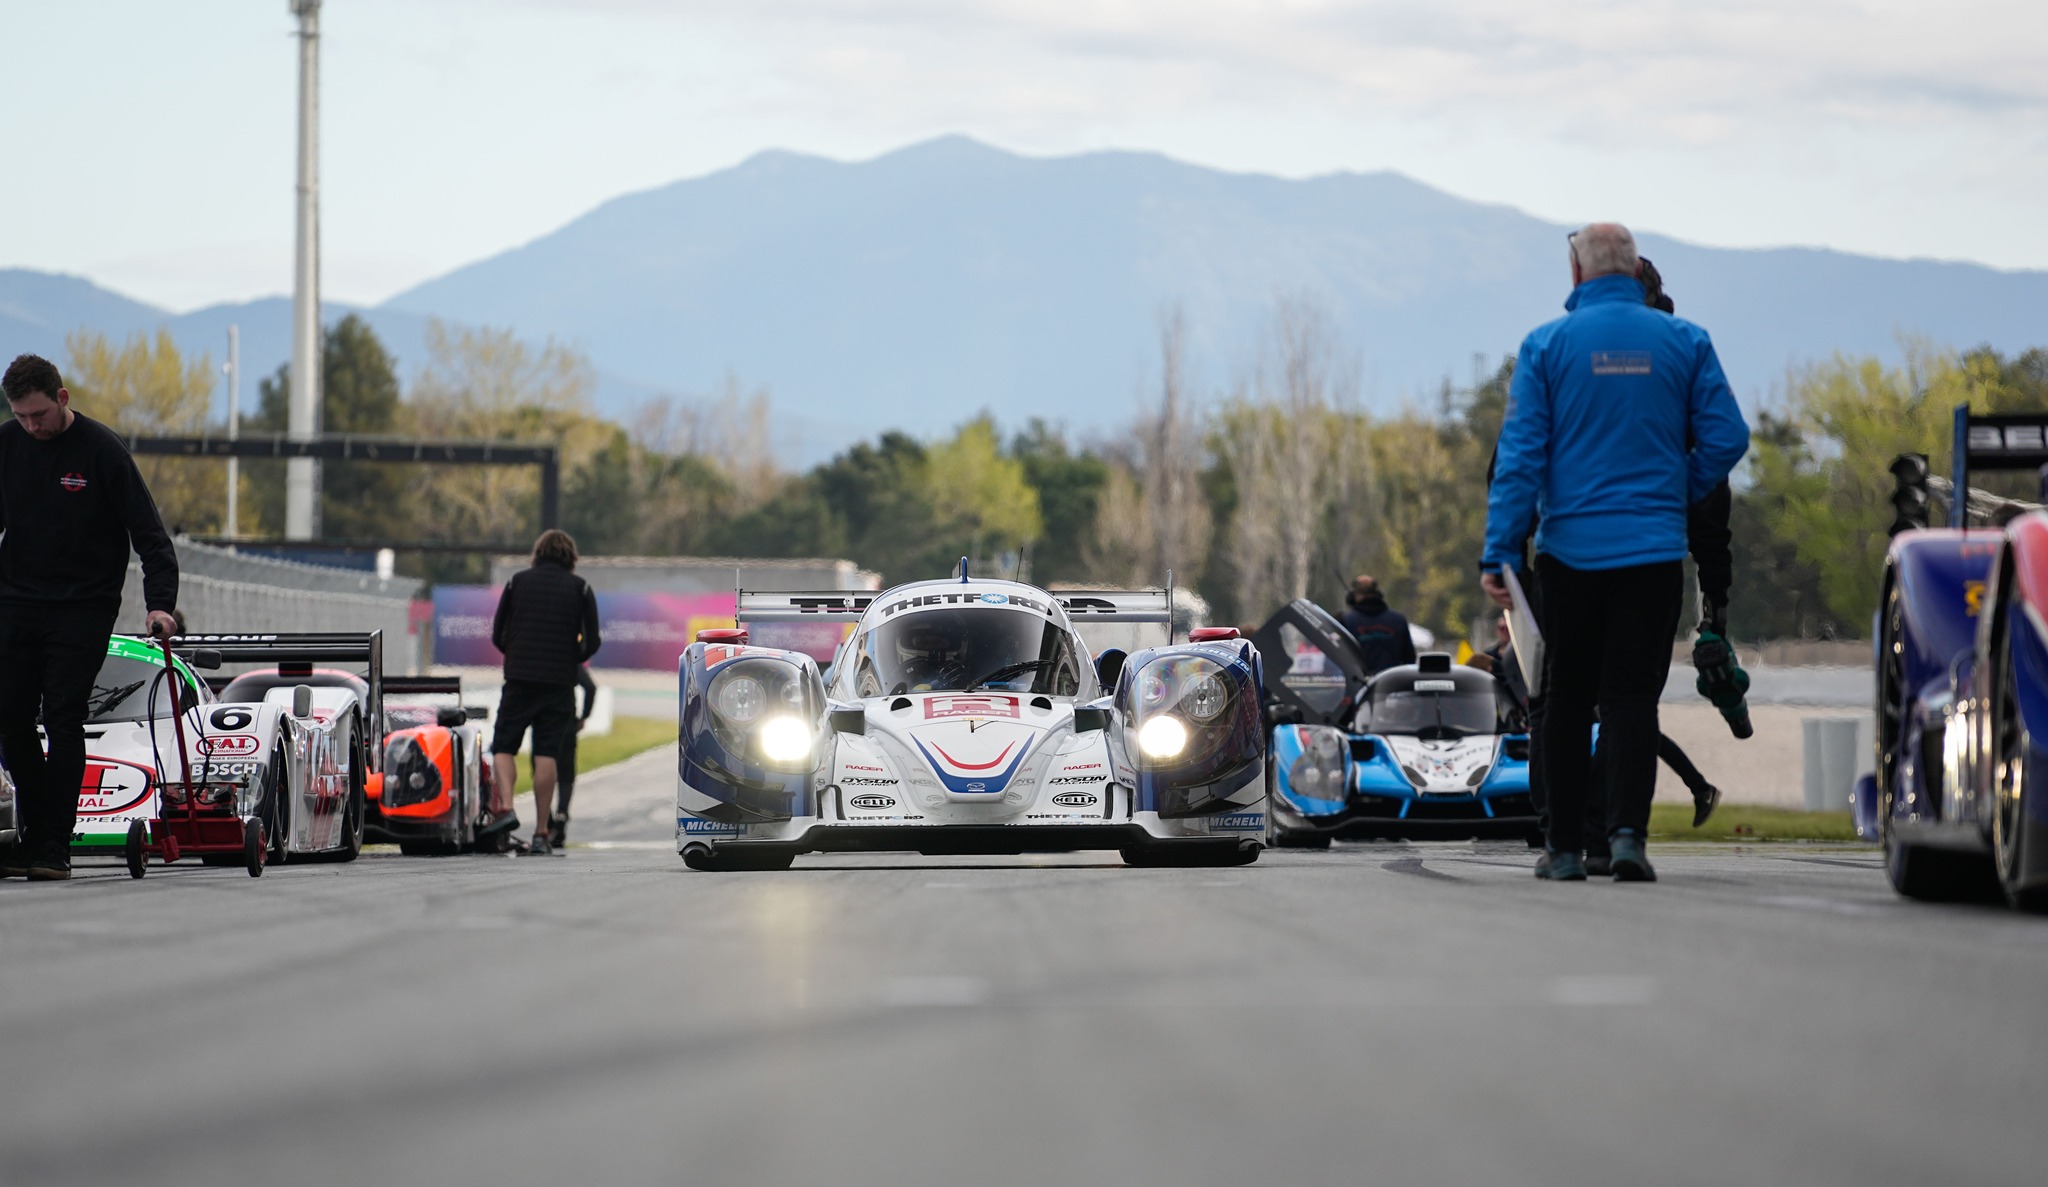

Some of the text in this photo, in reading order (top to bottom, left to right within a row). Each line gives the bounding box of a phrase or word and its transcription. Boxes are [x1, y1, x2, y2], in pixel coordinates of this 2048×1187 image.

[881, 593, 1053, 617] THETFORD
[933, 709, 1012, 717] RACER
[210, 706, 253, 731] 6
[191, 763, 258, 776] BOSCH
[845, 764, 884, 772] RACER
[1063, 763, 1102, 771] RACER
[841, 777, 900, 785] DYSON
[1049, 775, 1108, 784] DYSON
[852, 797, 897, 806] HELLA
[1054, 795, 1098, 804] HELLA
[686, 821, 747, 831] MICHELIN
